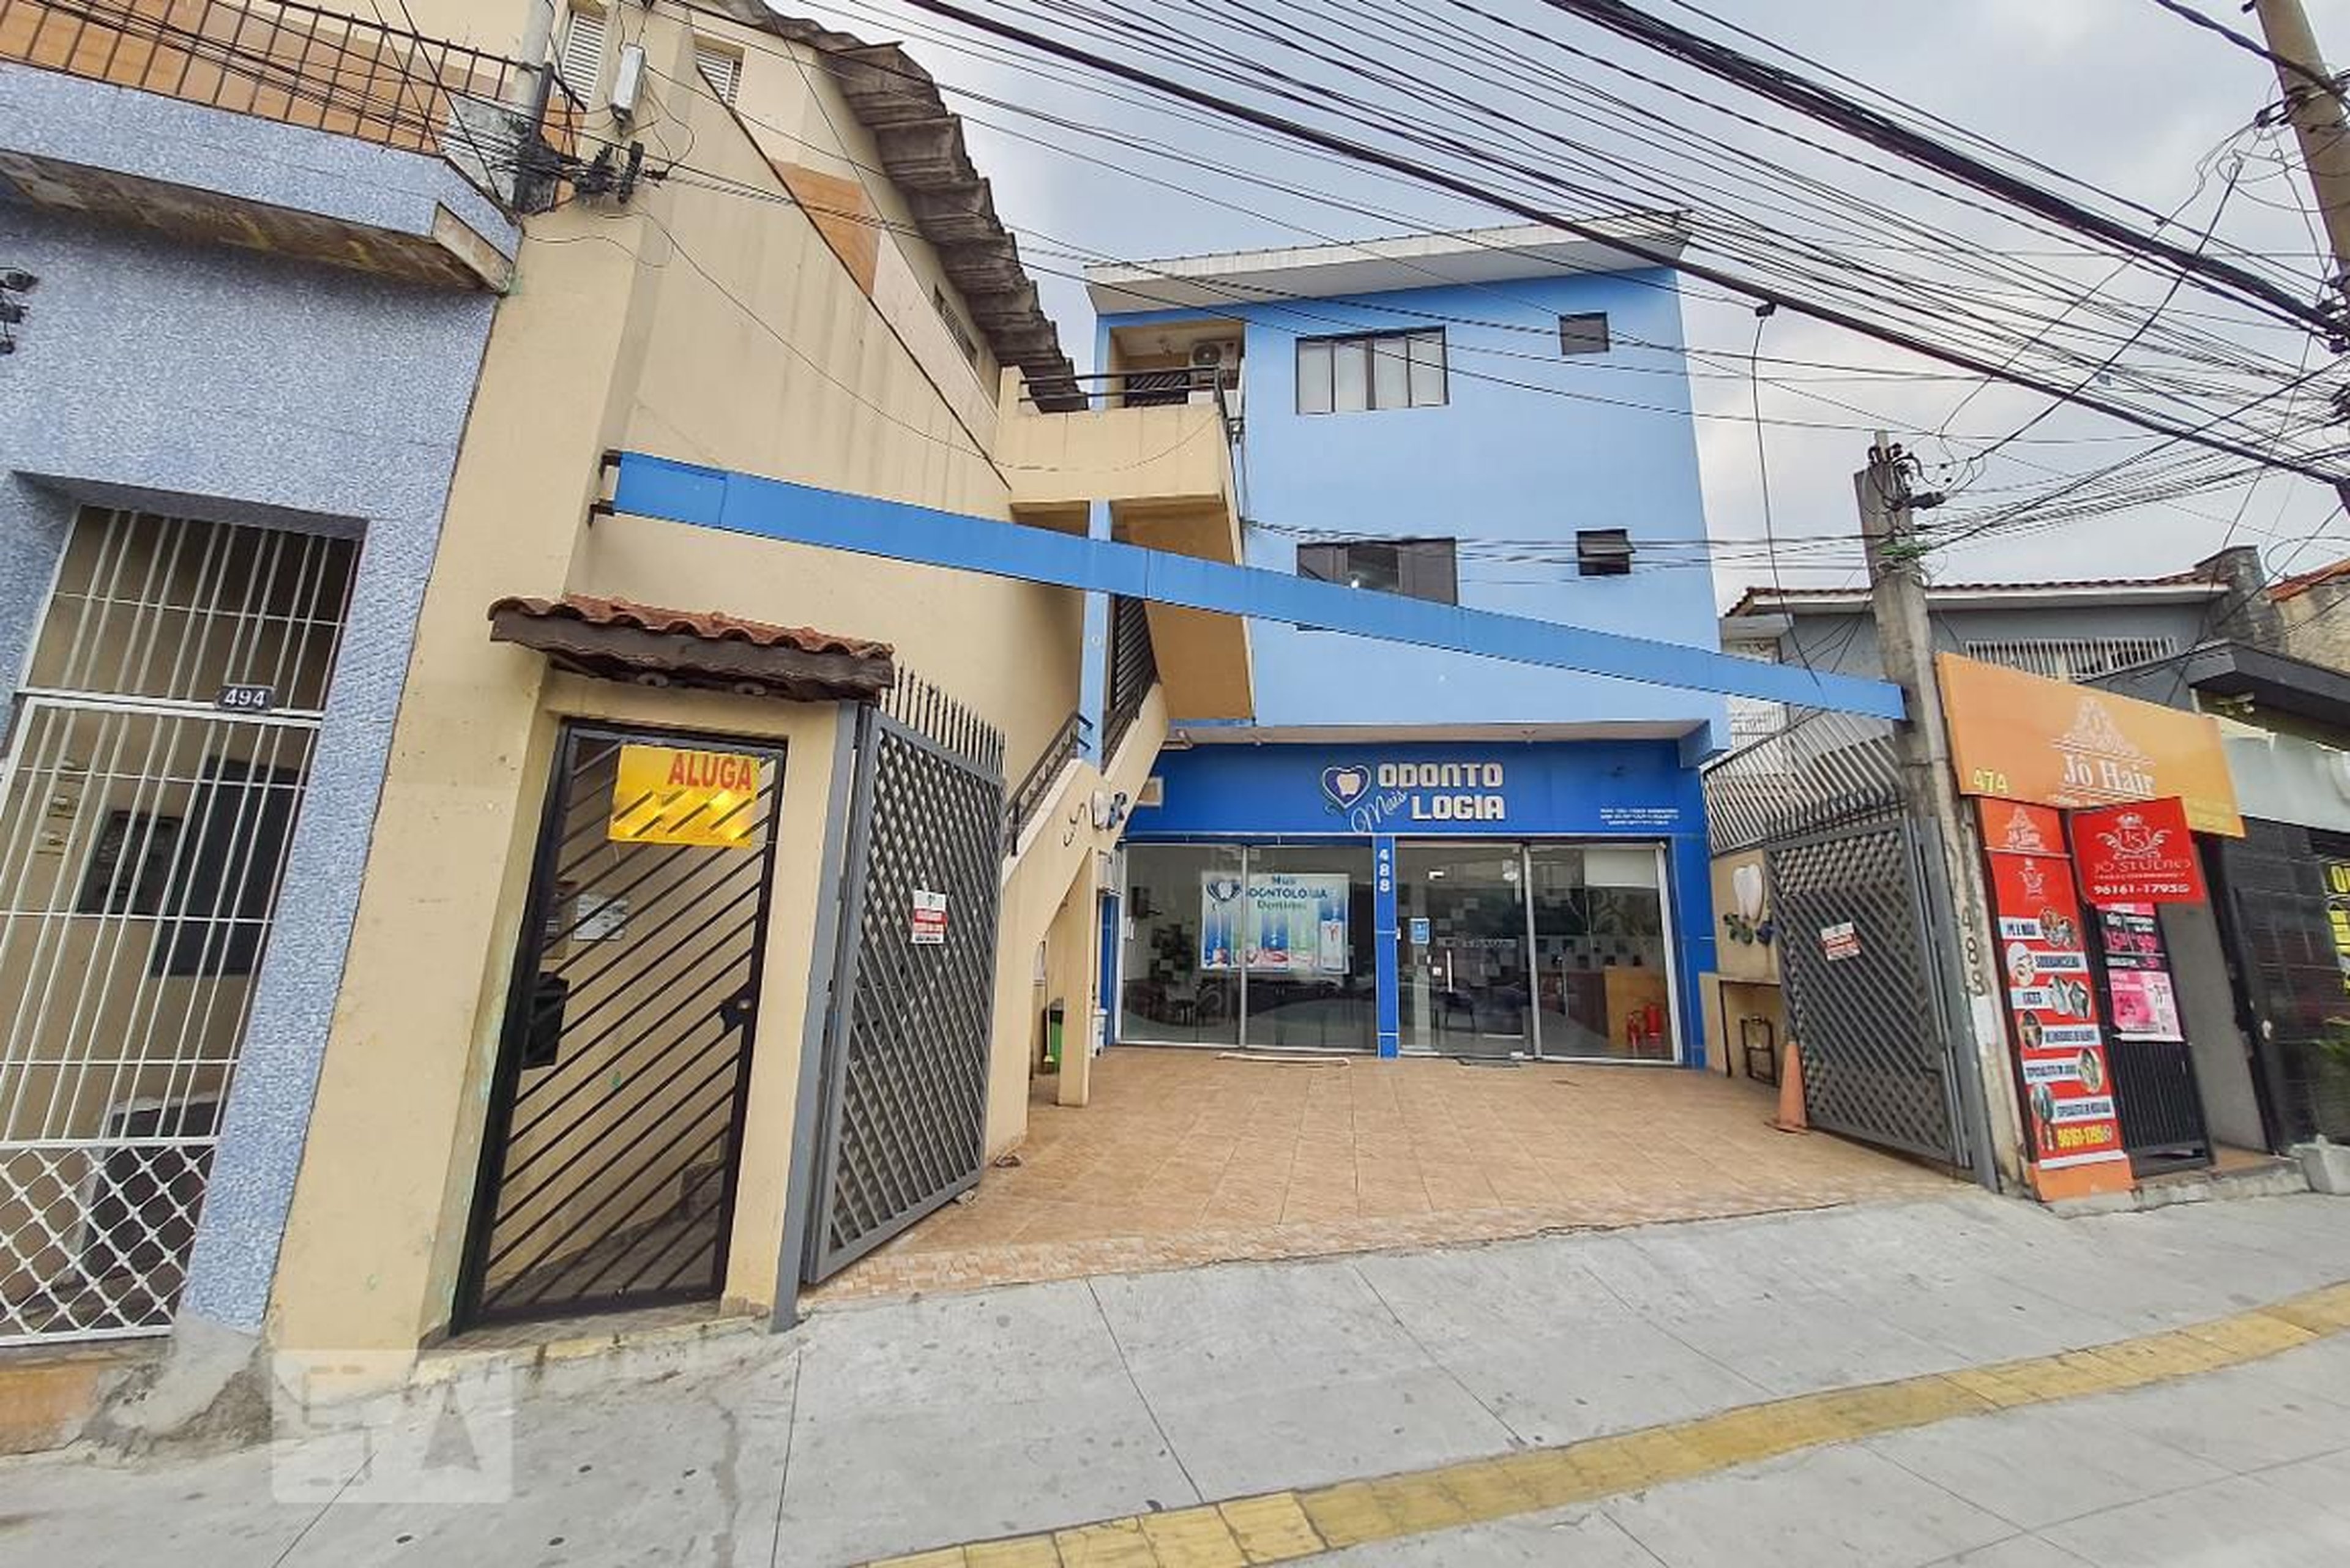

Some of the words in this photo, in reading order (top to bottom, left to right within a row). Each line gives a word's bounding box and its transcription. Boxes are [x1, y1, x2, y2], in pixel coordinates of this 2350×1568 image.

[223, 688, 266, 707] 494
[667, 752, 752, 791] ALUGA
[1377, 763, 1504, 788] ODONTO
[2098, 758, 2157, 796] Hair
[1411, 795, 1505, 821] LOGIA
[1378, 848, 1390, 892] 488
